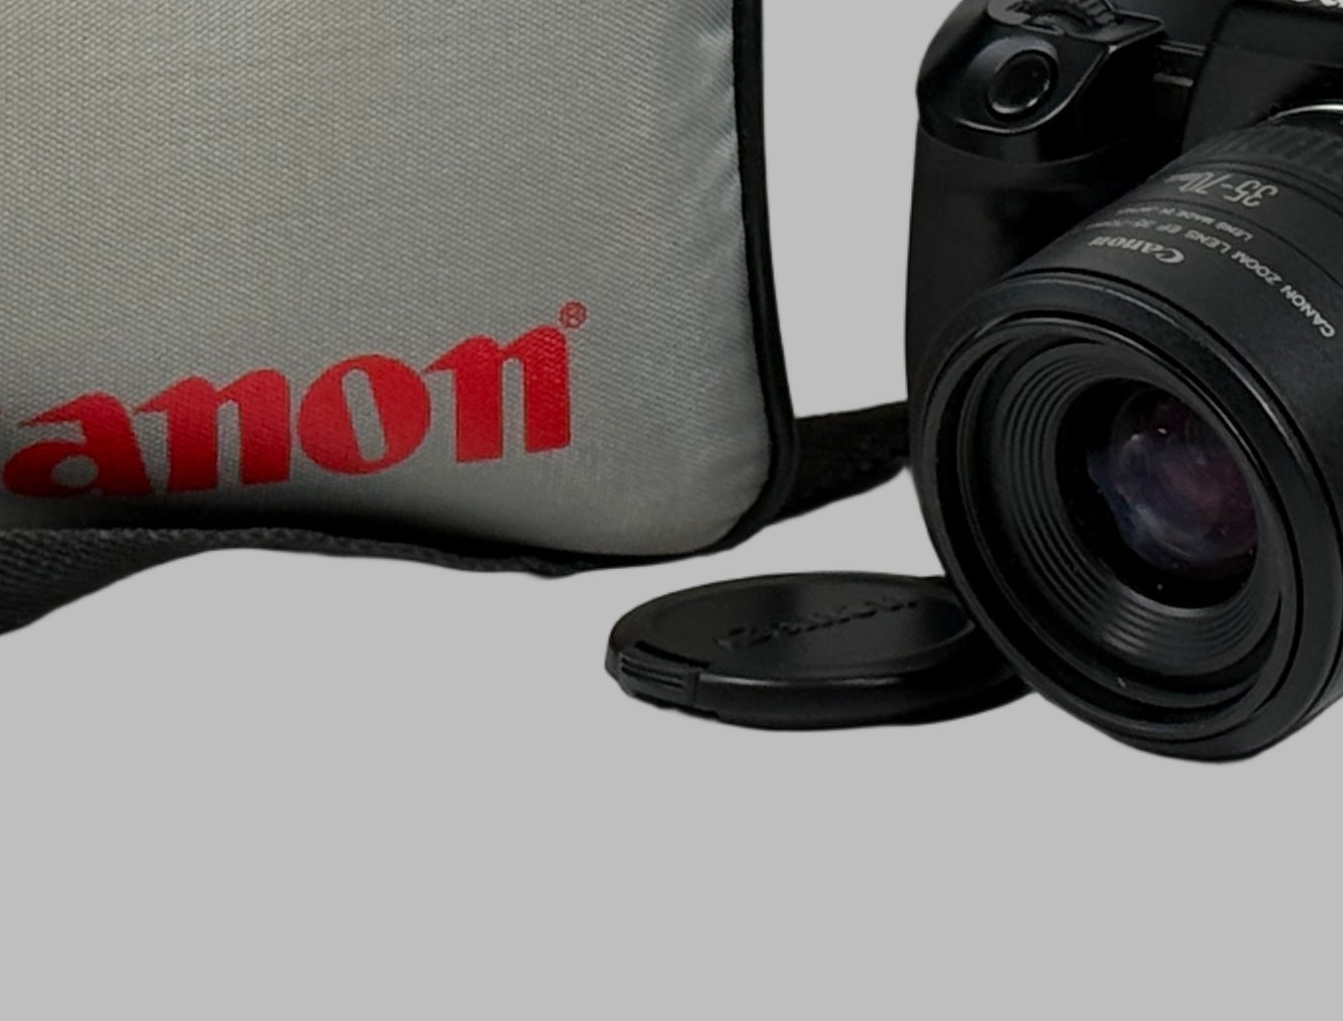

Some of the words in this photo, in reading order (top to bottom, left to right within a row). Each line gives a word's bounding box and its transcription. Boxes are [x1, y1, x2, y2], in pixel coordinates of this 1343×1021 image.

[1088, 236, 1185, 263] Canon
[1184, 230, 1231, 253] LENS
[1231, 251, 1282, 285] ZOOM
[1280, 284, 1335, 337] CANON
